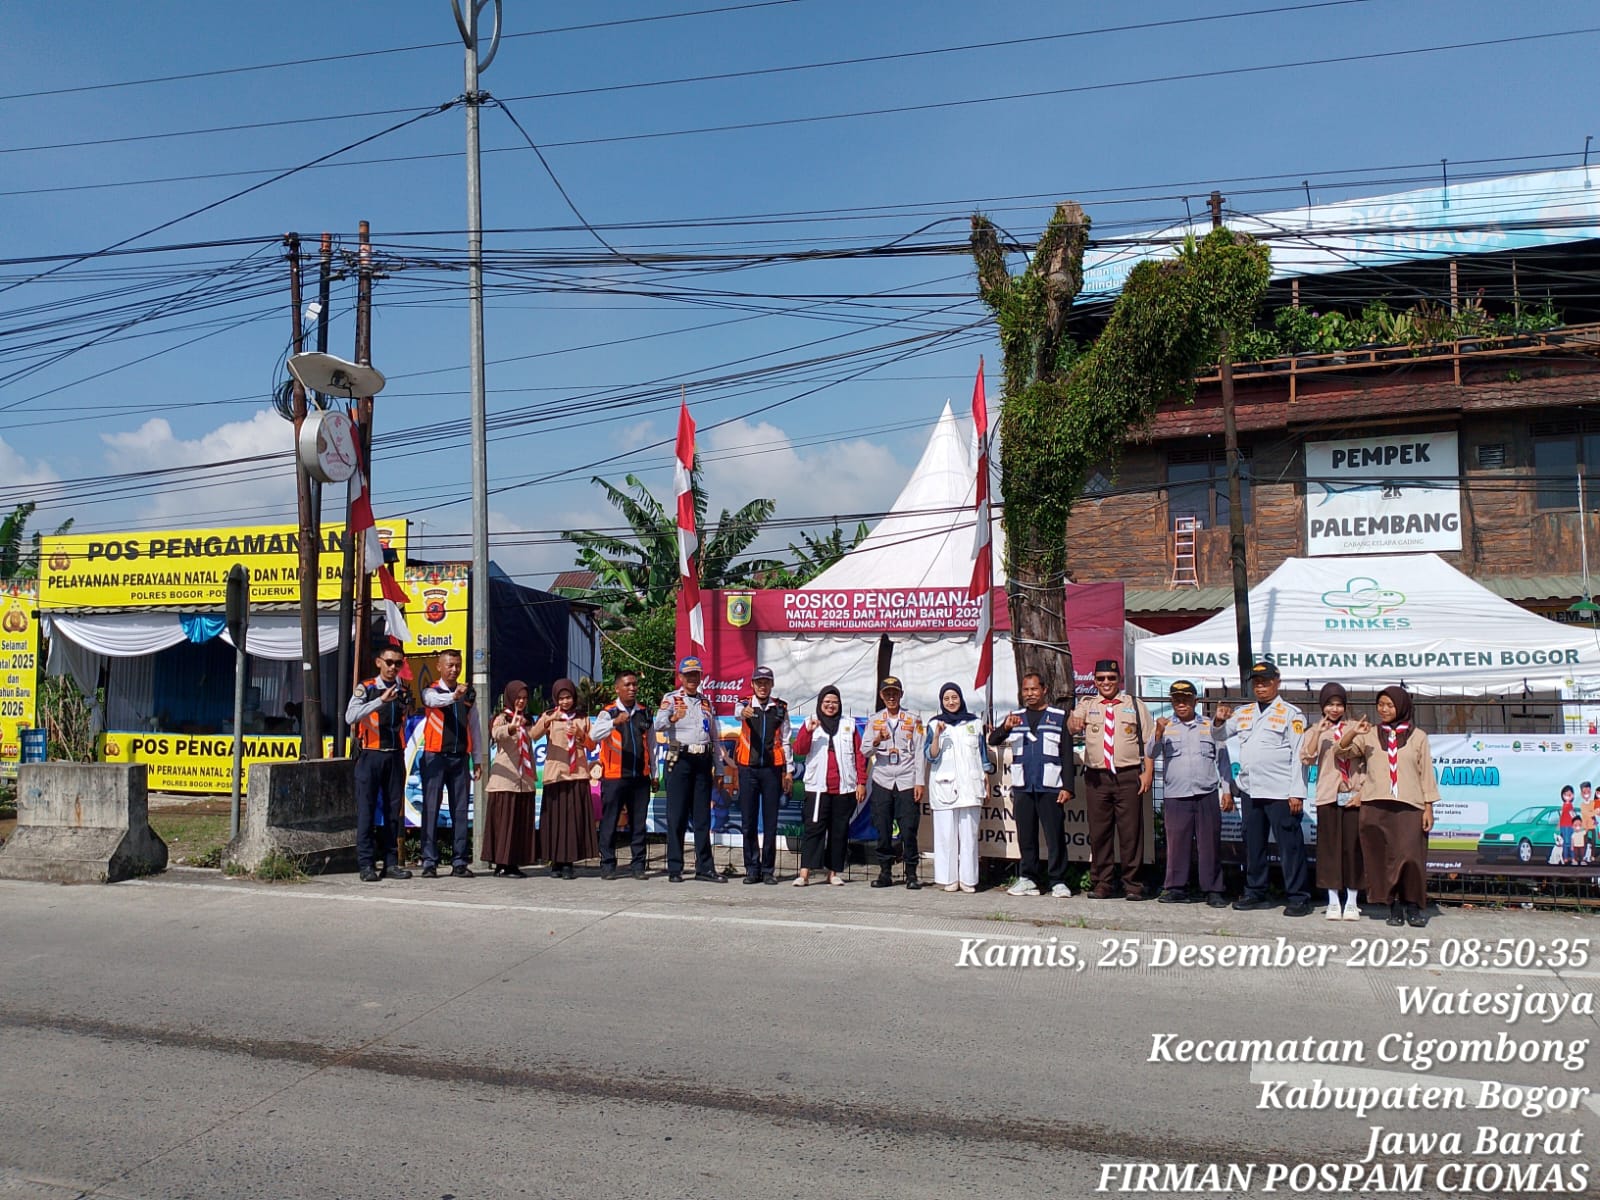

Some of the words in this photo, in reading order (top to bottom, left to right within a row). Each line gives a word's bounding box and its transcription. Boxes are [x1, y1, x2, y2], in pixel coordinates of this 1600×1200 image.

[1332, 443, 1430, 469] PEMPEK
[1382, 486, 1402, 499] 2K
[1311, 512, 1458, 538] PALEMBANG
[87, 540, 140, 562] POS
[48, 573, 119, 588] PELAYANAN
[123, 571, 181, 586] PERAYAAN
[184, 570, 219, 584] NATAL
[254, 568, 278, 582] DAN
[130, 590, 167, 600] POLRES
[170, 589, 203, 599] BOGOR
[251, 587, 294, 597] CIJERUK
[784, 593, 848, 609] POSKO
[853, 591, 982, 608] PENGAMANA
[786, 610, 819, 620] NATAL
[821, 610, 850, 620] 2025
[853, 609, 876, 619] DAN
[879, 609, 915, 619] TAHUN
[921, 608, 953, 618] BARU
[788, 620, 816, 629] DINAS
[818, 619, 887, 628] PERHUBUNGAN
[889, 619, 945, 628] KABUPATEN
[1325, 617, 1410, 629] DINKES
[1, 640, 27, 650] Selamat
[417, 634, 452, 646] Selamat
[12, 653, 34, 669] 2025
[1171, 652, 1230, 666] DINAS
[1238, 652, 1357, 667] ESEHATAN
[1364, 651, 1492, 668] KABUPATEN
[1500, 649, 1580, 665] BOGOR
[8, 674, 19, 684] dan
[715, 694, 739, 703] 2025
[1, 701, 24, 716] 2026
[132, 738, 169, 755] POS
[157, 765, 198, 776] PERAYAAN
[199, 766, 224, 778] NATAL
[163, 780, 188, 788] POLRES
[189, 780, 213, 788] BOGOR
